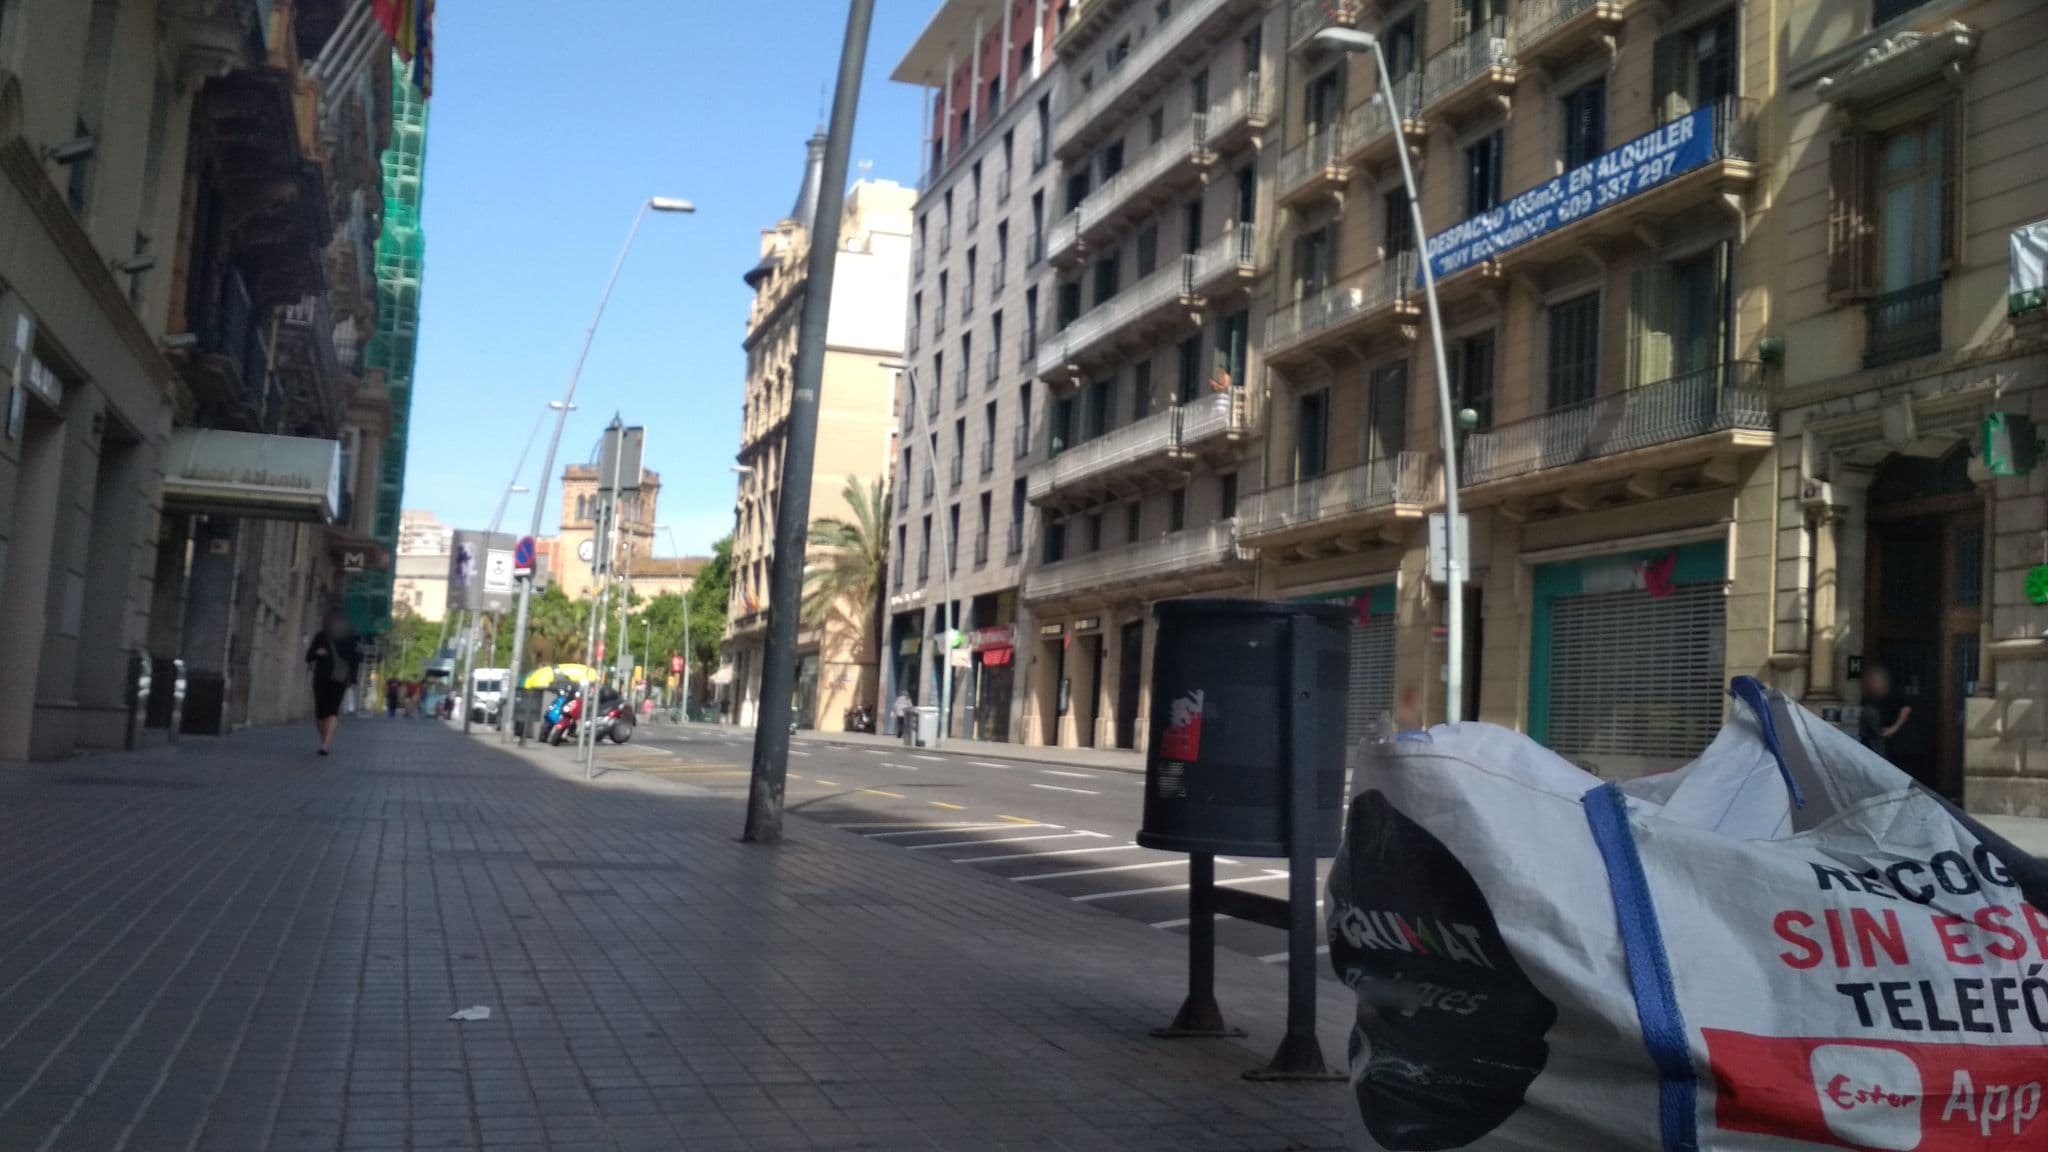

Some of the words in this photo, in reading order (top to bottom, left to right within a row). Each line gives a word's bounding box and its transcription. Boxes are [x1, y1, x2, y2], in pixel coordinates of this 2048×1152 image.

[1568, 161, 1593, 194] EN
[1597, 114, 1695, 179] ALQUILER
[1637, 151, 1677, 188] 297
[1772, 908, 1909, 970] SIN
[1941, 1069, 2042, 1137] App
